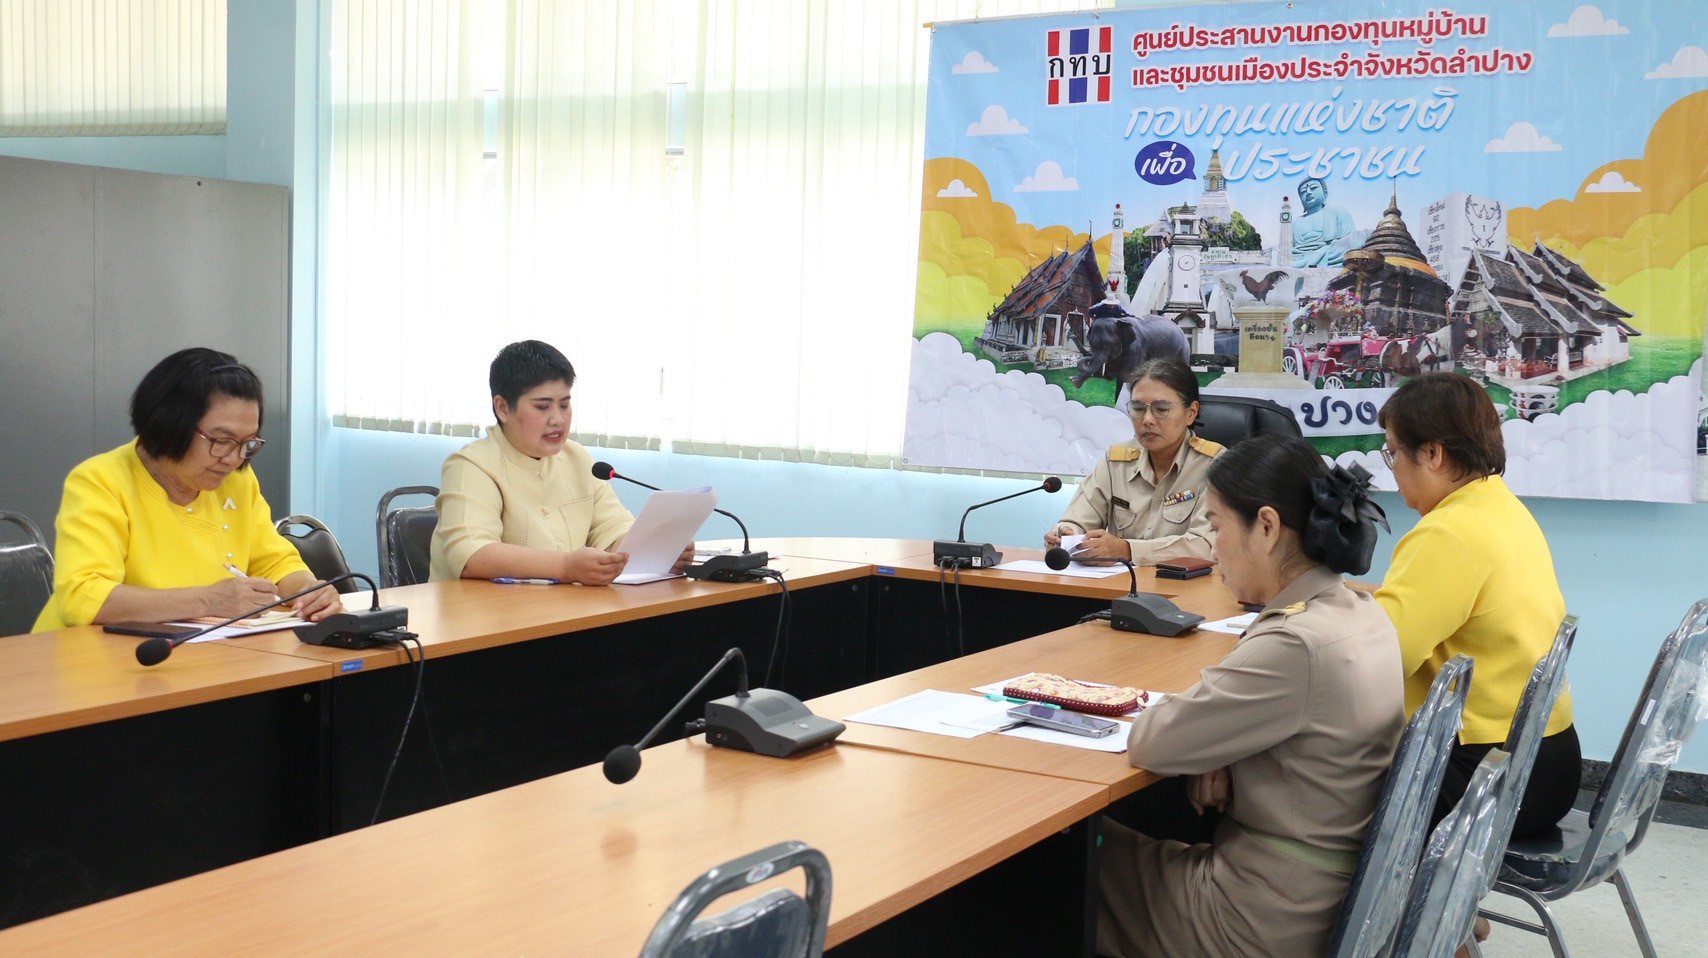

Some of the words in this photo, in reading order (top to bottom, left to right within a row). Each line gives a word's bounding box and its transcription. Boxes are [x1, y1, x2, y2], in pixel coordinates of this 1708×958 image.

[1132, 10, 1487, 57] ศูนย์ประสานงานกองทุนหมู่บ้าน
[1132, 47, 1532, 90] และชุมชนเมืองประจำจังหวัดลำปาง
[1123, 86, 1459, 150] กองทุนแห่งชาติ
[1140, 143, 1187, 176] เพื่อ
[1222, 142, 1425, 181] ประชาชน
